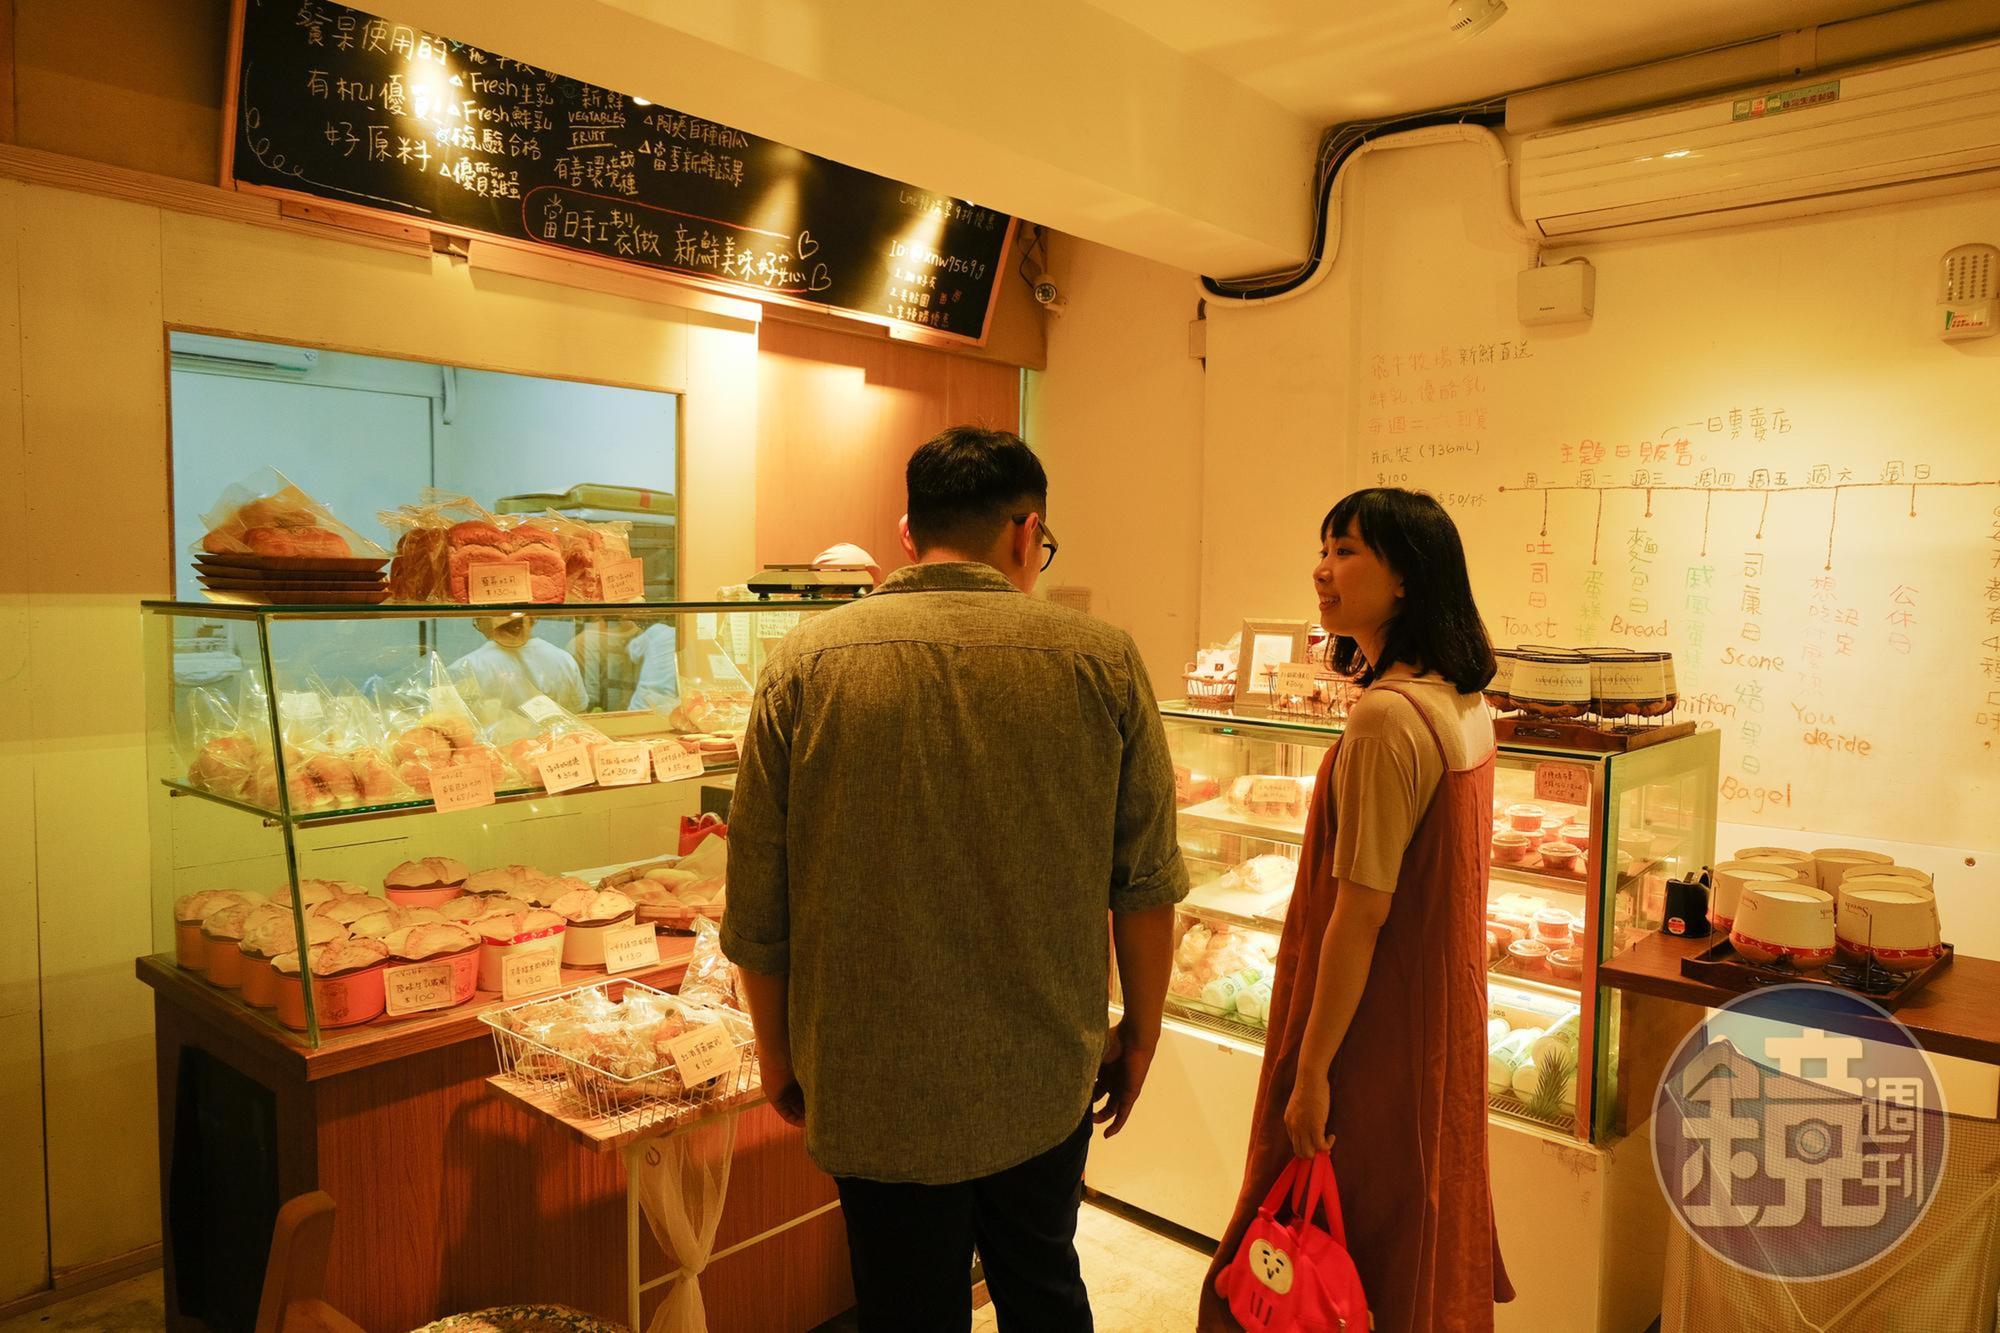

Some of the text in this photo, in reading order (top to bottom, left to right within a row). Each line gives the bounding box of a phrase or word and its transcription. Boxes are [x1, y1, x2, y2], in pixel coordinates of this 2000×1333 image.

[324, 121, 432, 172] 好原料
[572, 131, 606, 145] FRUIT
[1749, 468, 1788, 488] 週五
[1806, 464, 1853, 485] 週六
[1880, 460, 1931, 482] 週日
[1526, 540, 1555, 609] 吐司日
[1501, 615, 1559, 638] Toast
[1610, 614, 1668, 638] Bread
[1720, 646, 1785, 672] Scone
[1676, 693, 1737, 720] hiffon
[1790, 701, 1837, 727] You
[1803, 728, 1873, 756] decide
[1720, 776, 1792, 815] Bagel
